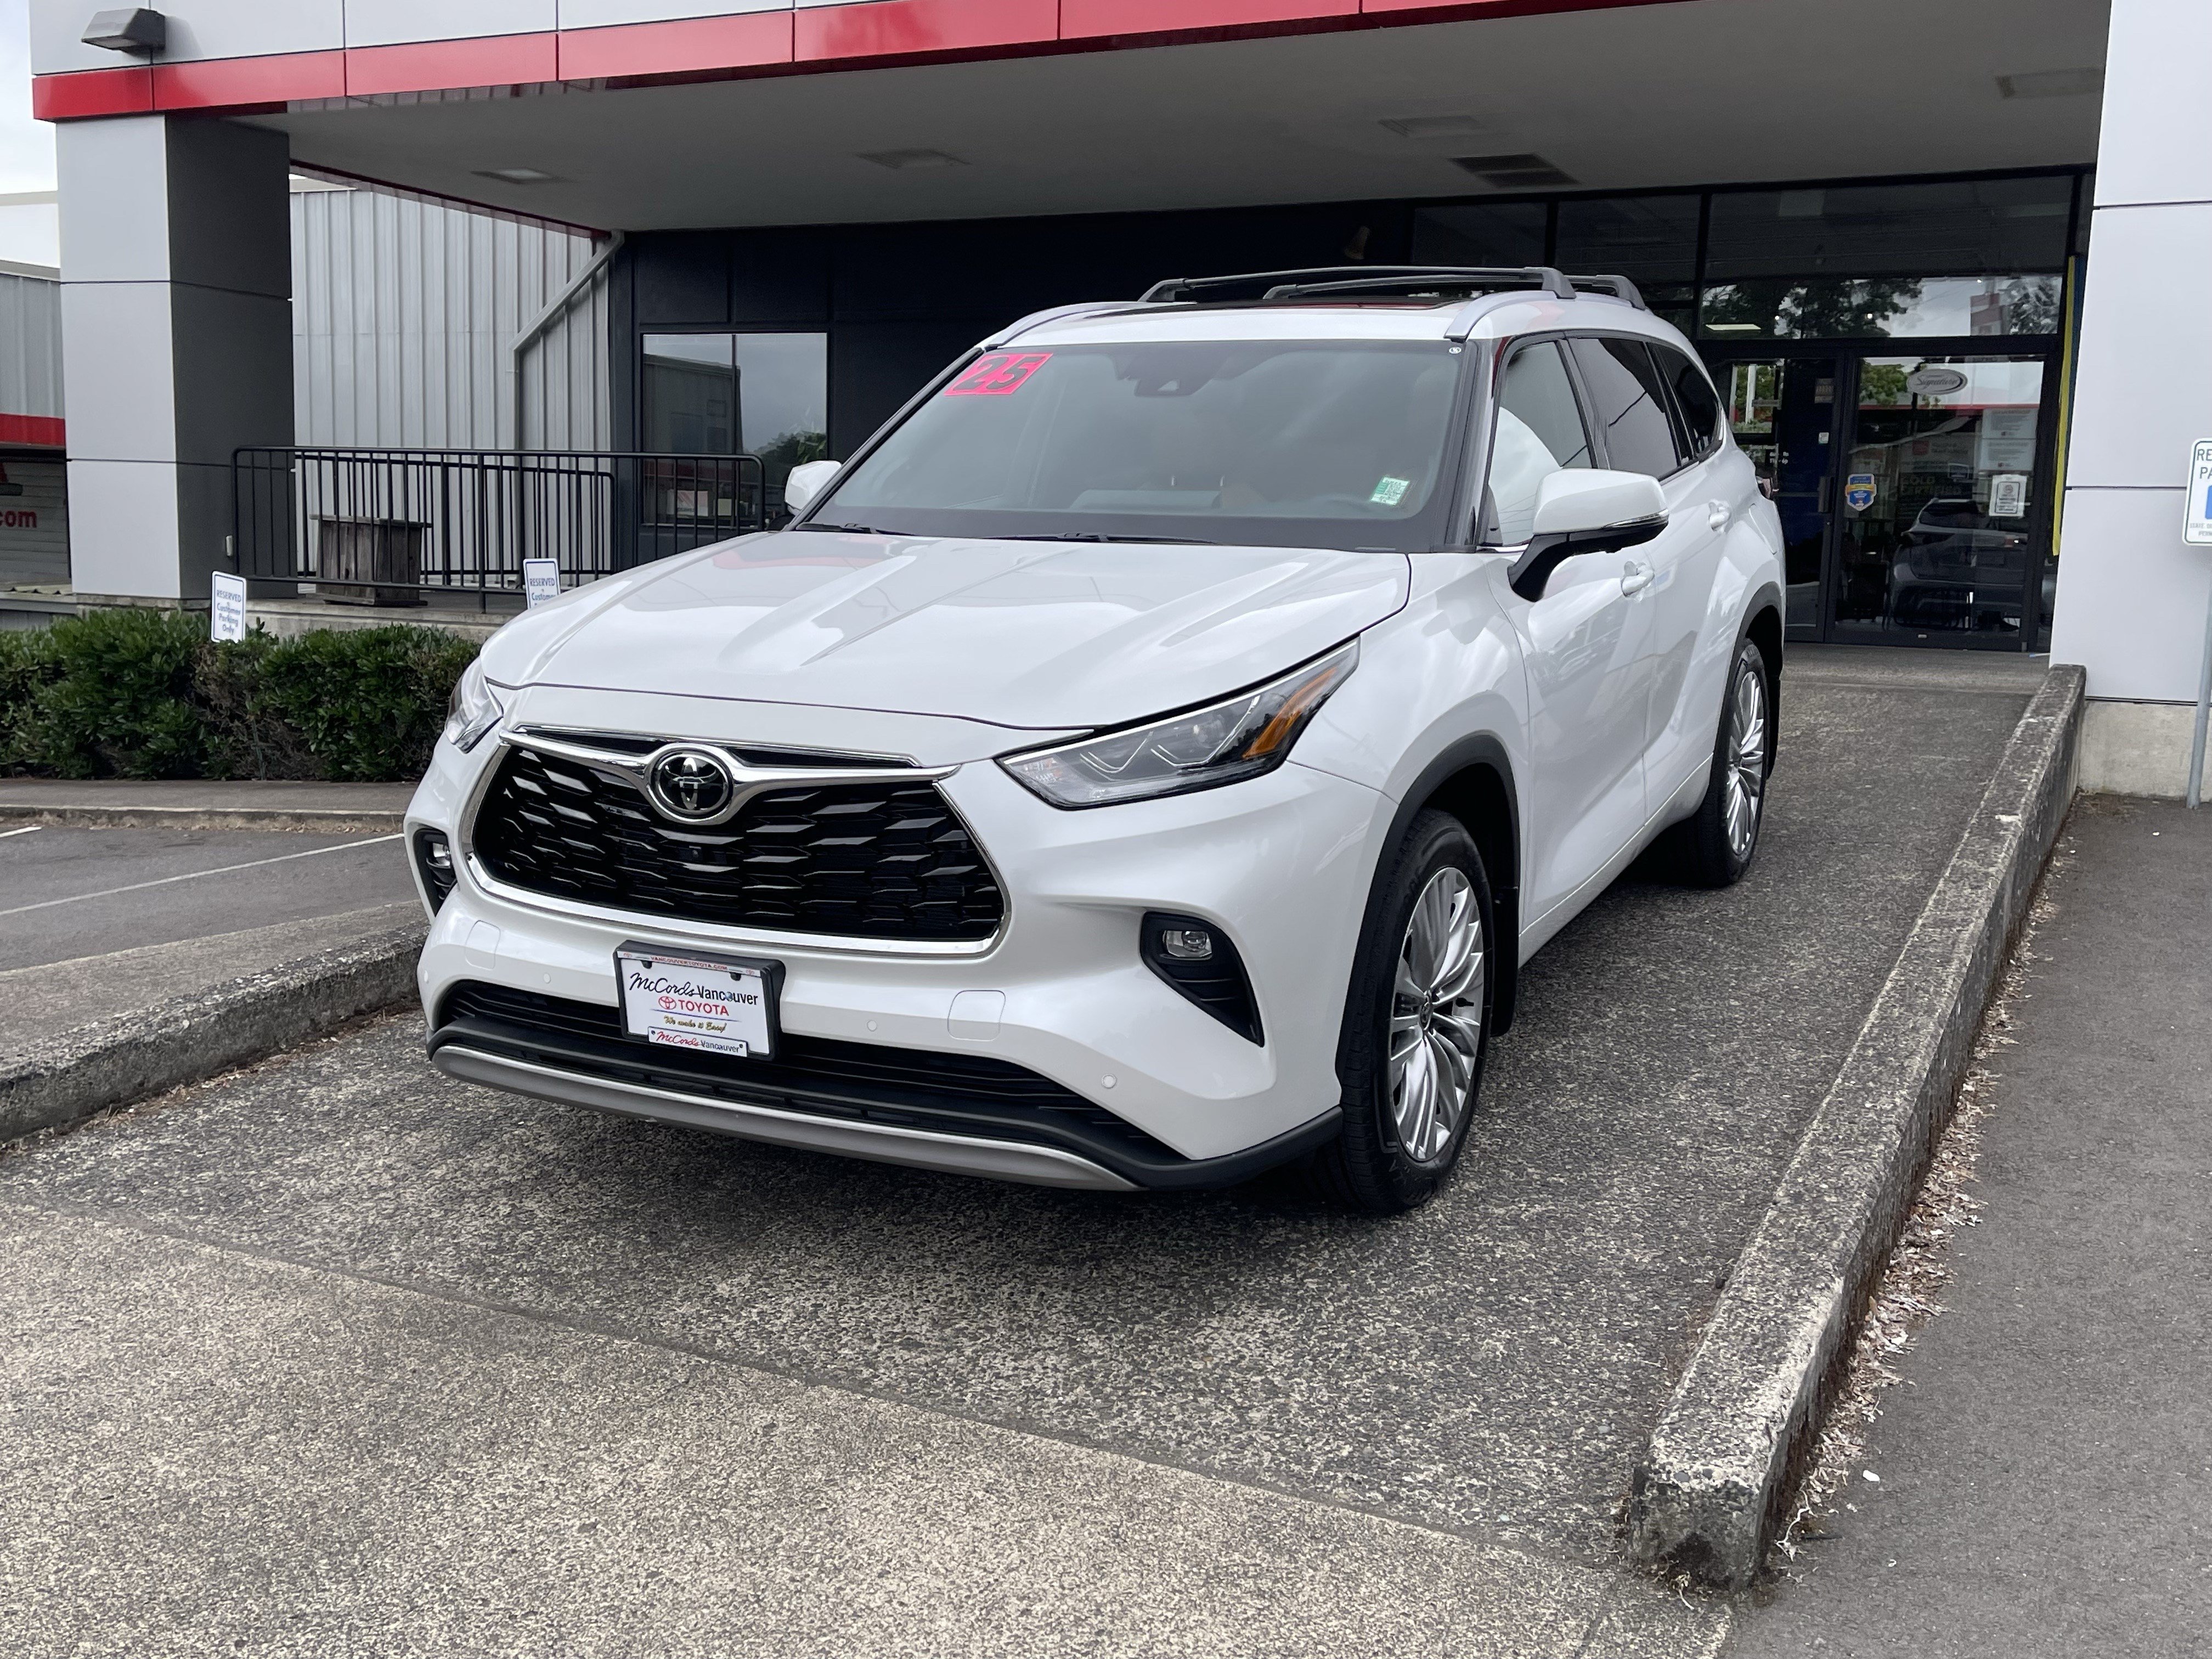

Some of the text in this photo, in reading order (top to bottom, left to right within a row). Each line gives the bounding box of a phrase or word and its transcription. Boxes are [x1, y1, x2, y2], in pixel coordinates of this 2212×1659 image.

[953, 357, 1046, 391] 25
[529, 578, 555, 586] RESERVED
[217, 590, 241, 602] RESERVED
[531, 592, 556, 601] Custom
[219, 613, 239, 627] Parking
[222, 624, 234, 635] Only
[678, 999, 729, 1016] TOYOTA
[701, 1040, 740, 1053] Vancouver
